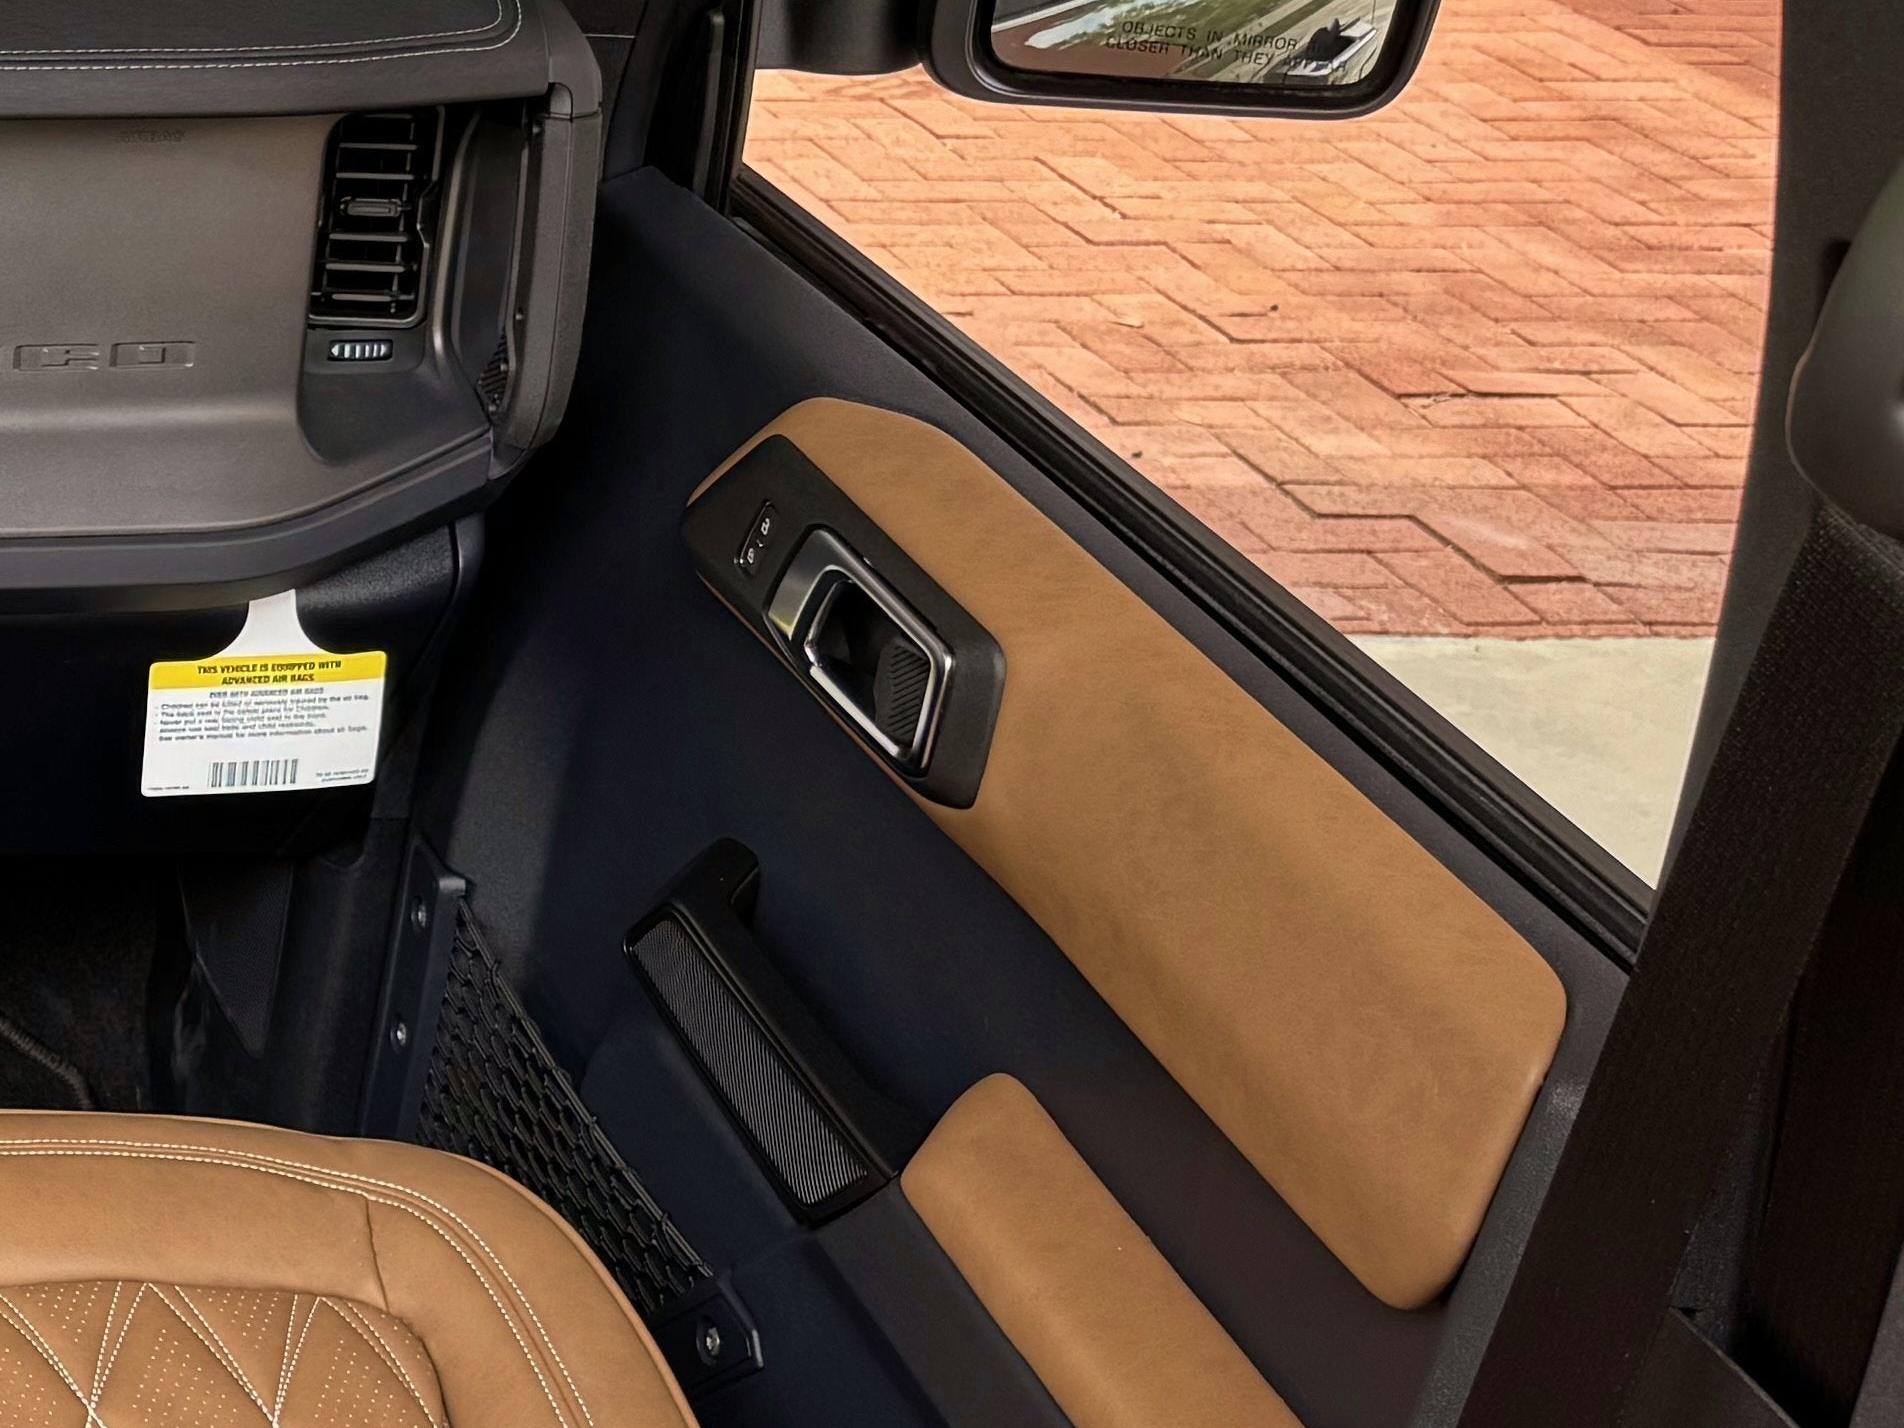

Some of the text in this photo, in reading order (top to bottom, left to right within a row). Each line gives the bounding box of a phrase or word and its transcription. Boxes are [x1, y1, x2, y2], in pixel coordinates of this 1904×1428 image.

[1122, 20, 1197, 41] OBJECTS
[1206, 30, 1224, 43] IN
[1233, 32, 1297, 51] MIRROR
[1106, 35, 1169, 55] CLOSER
[1180, 46, 1223, 61] THAN
[1234, 50, 1274, 66] THEY
[198, 660, 342, 675] THIS VEHICLE IS EQUIPPED WITH
[221, 673, 314, 685] ADVANCED AIR BAGS
